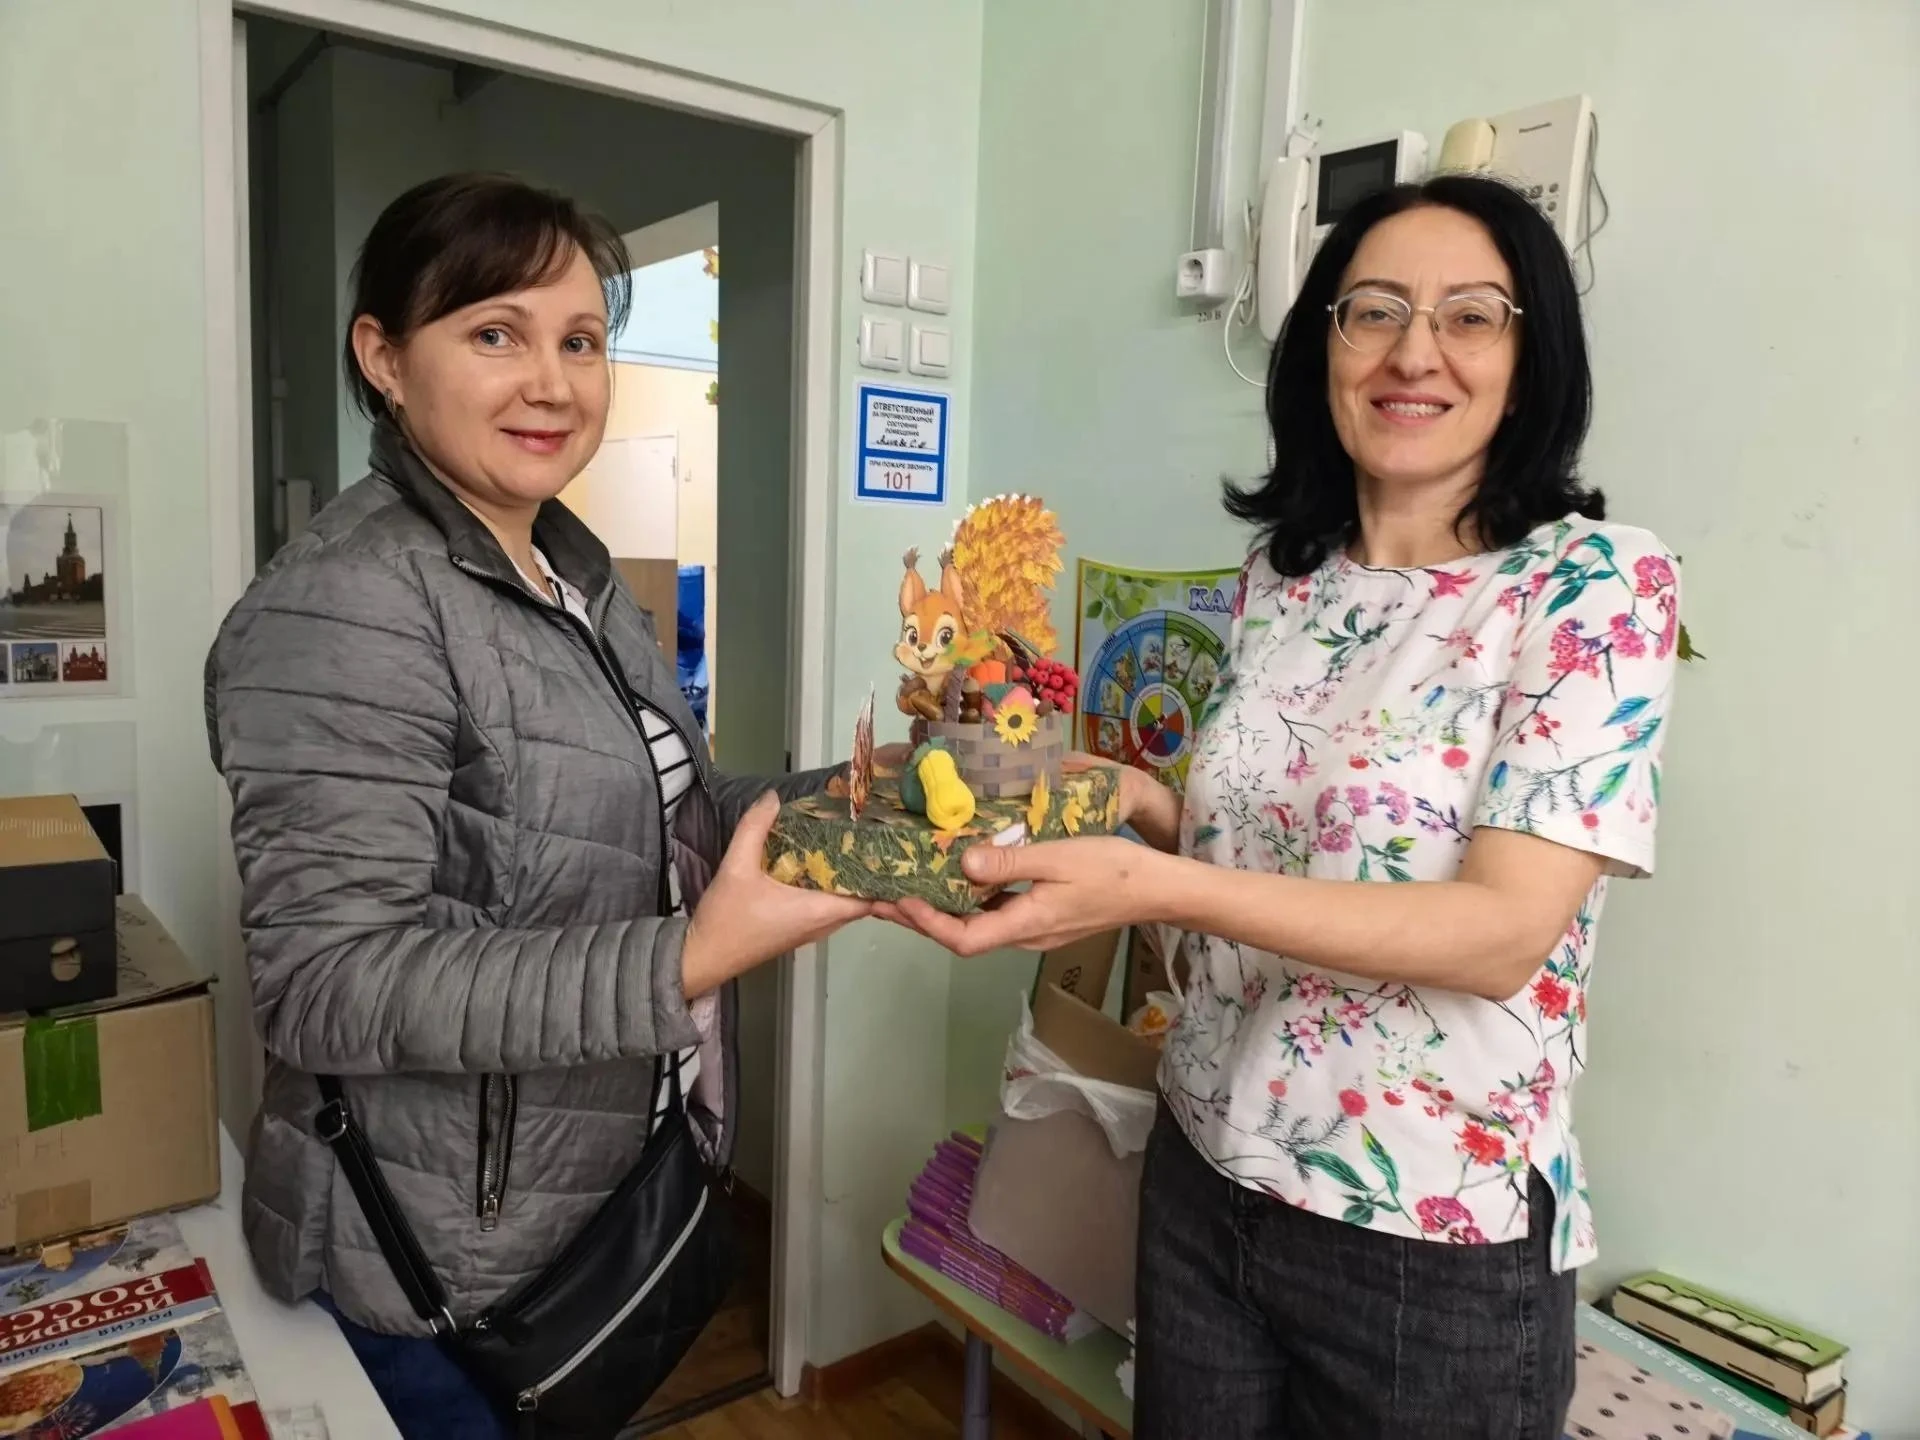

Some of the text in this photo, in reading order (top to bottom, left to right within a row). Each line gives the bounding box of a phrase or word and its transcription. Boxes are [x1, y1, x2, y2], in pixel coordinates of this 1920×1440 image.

[873, 401, 935, 416] ОТВЕТСТВЕННЫЙ
[884, 471, 911, 491] 101
[0, 1274, 169, 1335] РОСС
[98, 1310, 172, 1337] РОССИЯ
